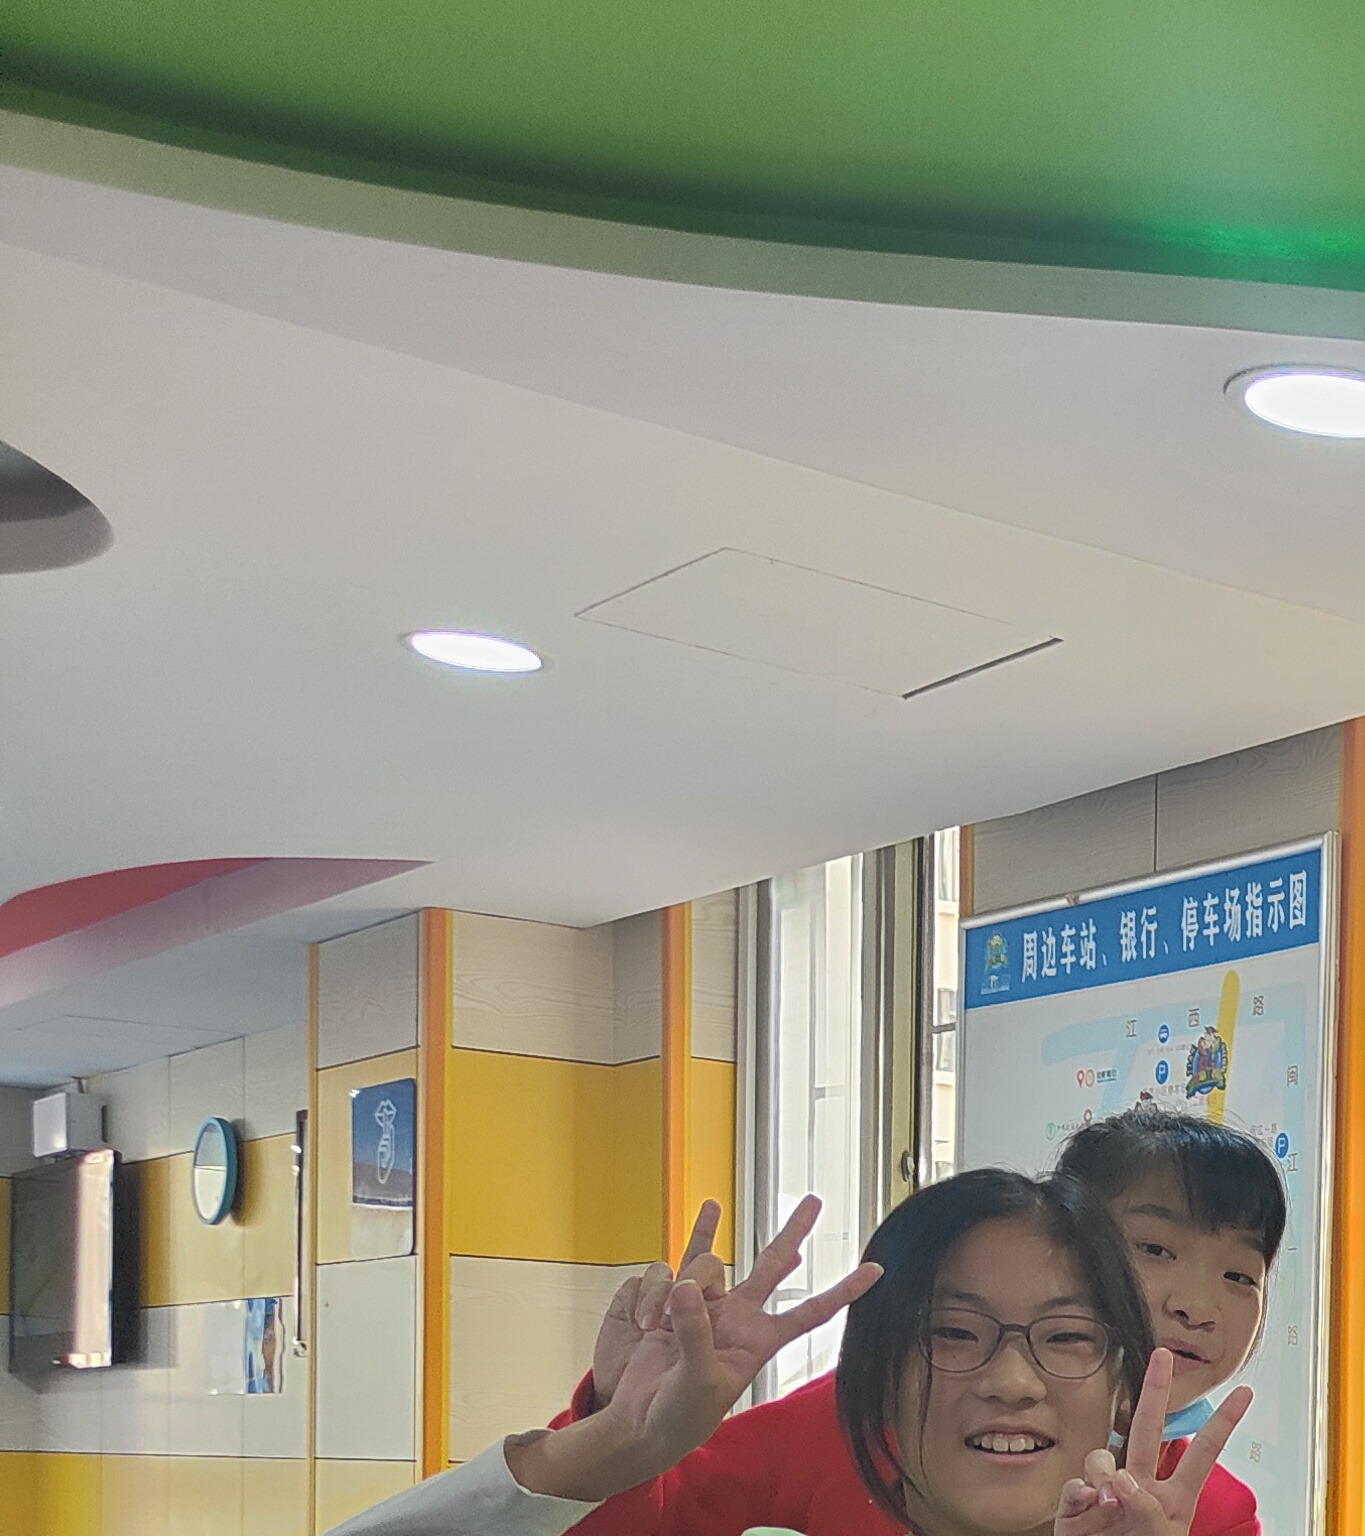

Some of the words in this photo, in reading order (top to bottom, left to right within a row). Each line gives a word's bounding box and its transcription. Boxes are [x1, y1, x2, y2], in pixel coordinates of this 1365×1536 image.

[1021, 869, 1308, 983] 周边车站、银行、停车场指示图
[1126, 1019, 1138, 1038] 江
[1188, 1007, 1200, 1028] 西
[1252, 995, 1265, 1016] 路
